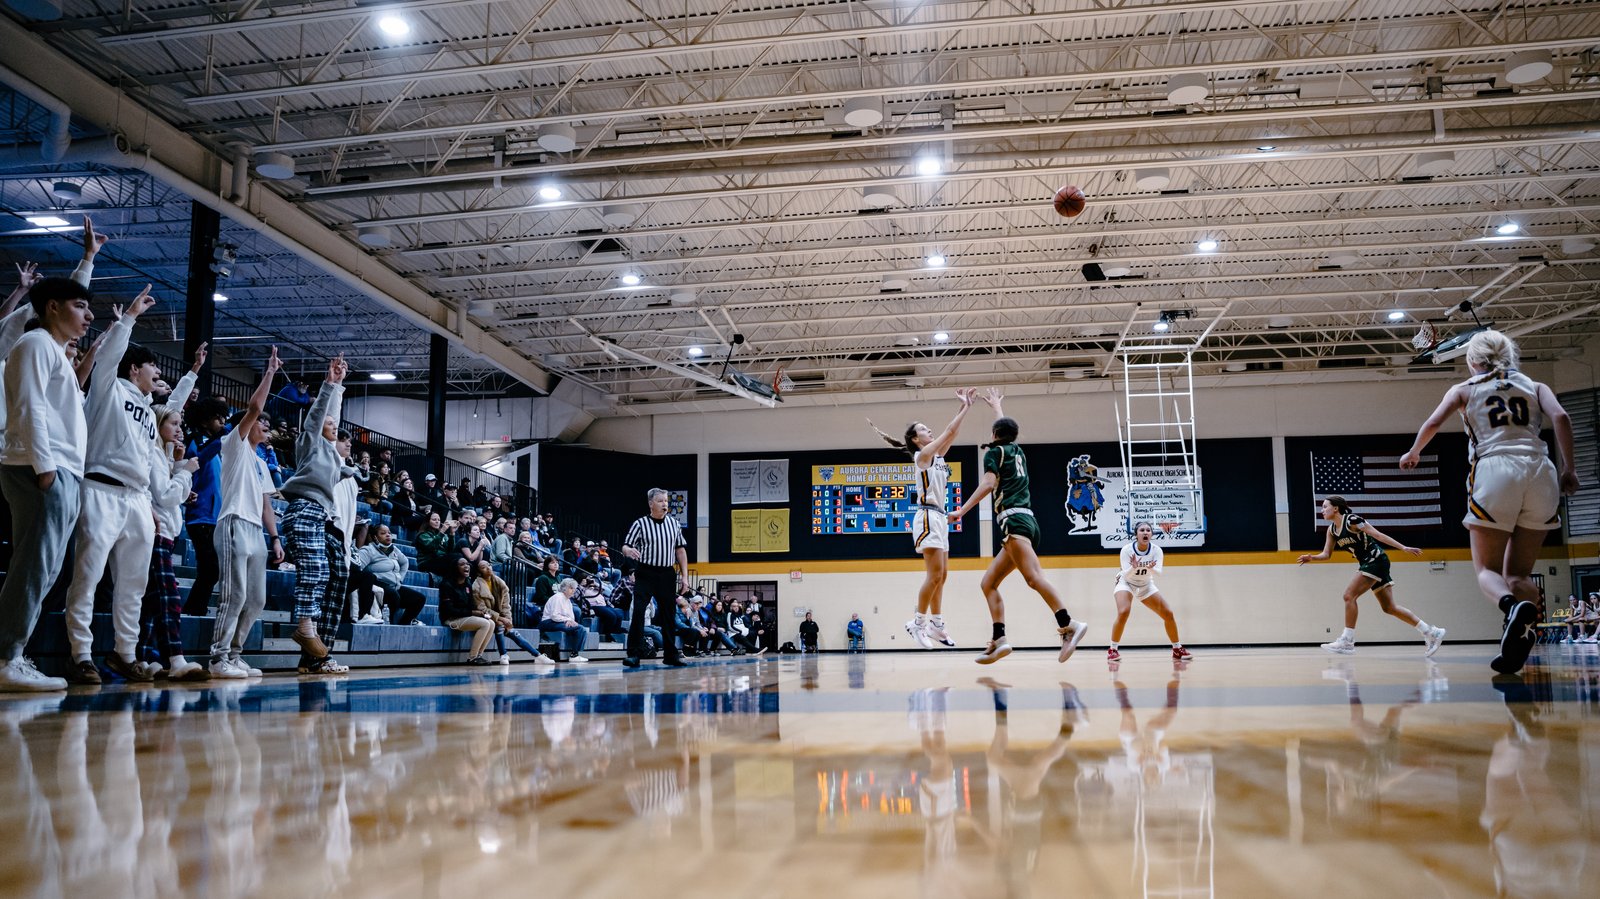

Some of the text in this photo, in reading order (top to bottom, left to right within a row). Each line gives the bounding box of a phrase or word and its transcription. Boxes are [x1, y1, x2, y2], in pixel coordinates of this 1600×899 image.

[1485, 396, 1529, 428] 20
[840, 466, 868, 474] AURORA
[870, 465, 900, 474] CENTRAL
[902, 464, 916, 472] CAT
[1143, 469, 1164, 478] CATHOLIC
[1164, 468, 1176, 477] HIGH
[875, 486, 904, 498] 2:32
[855, 494, 862, 505] 4
